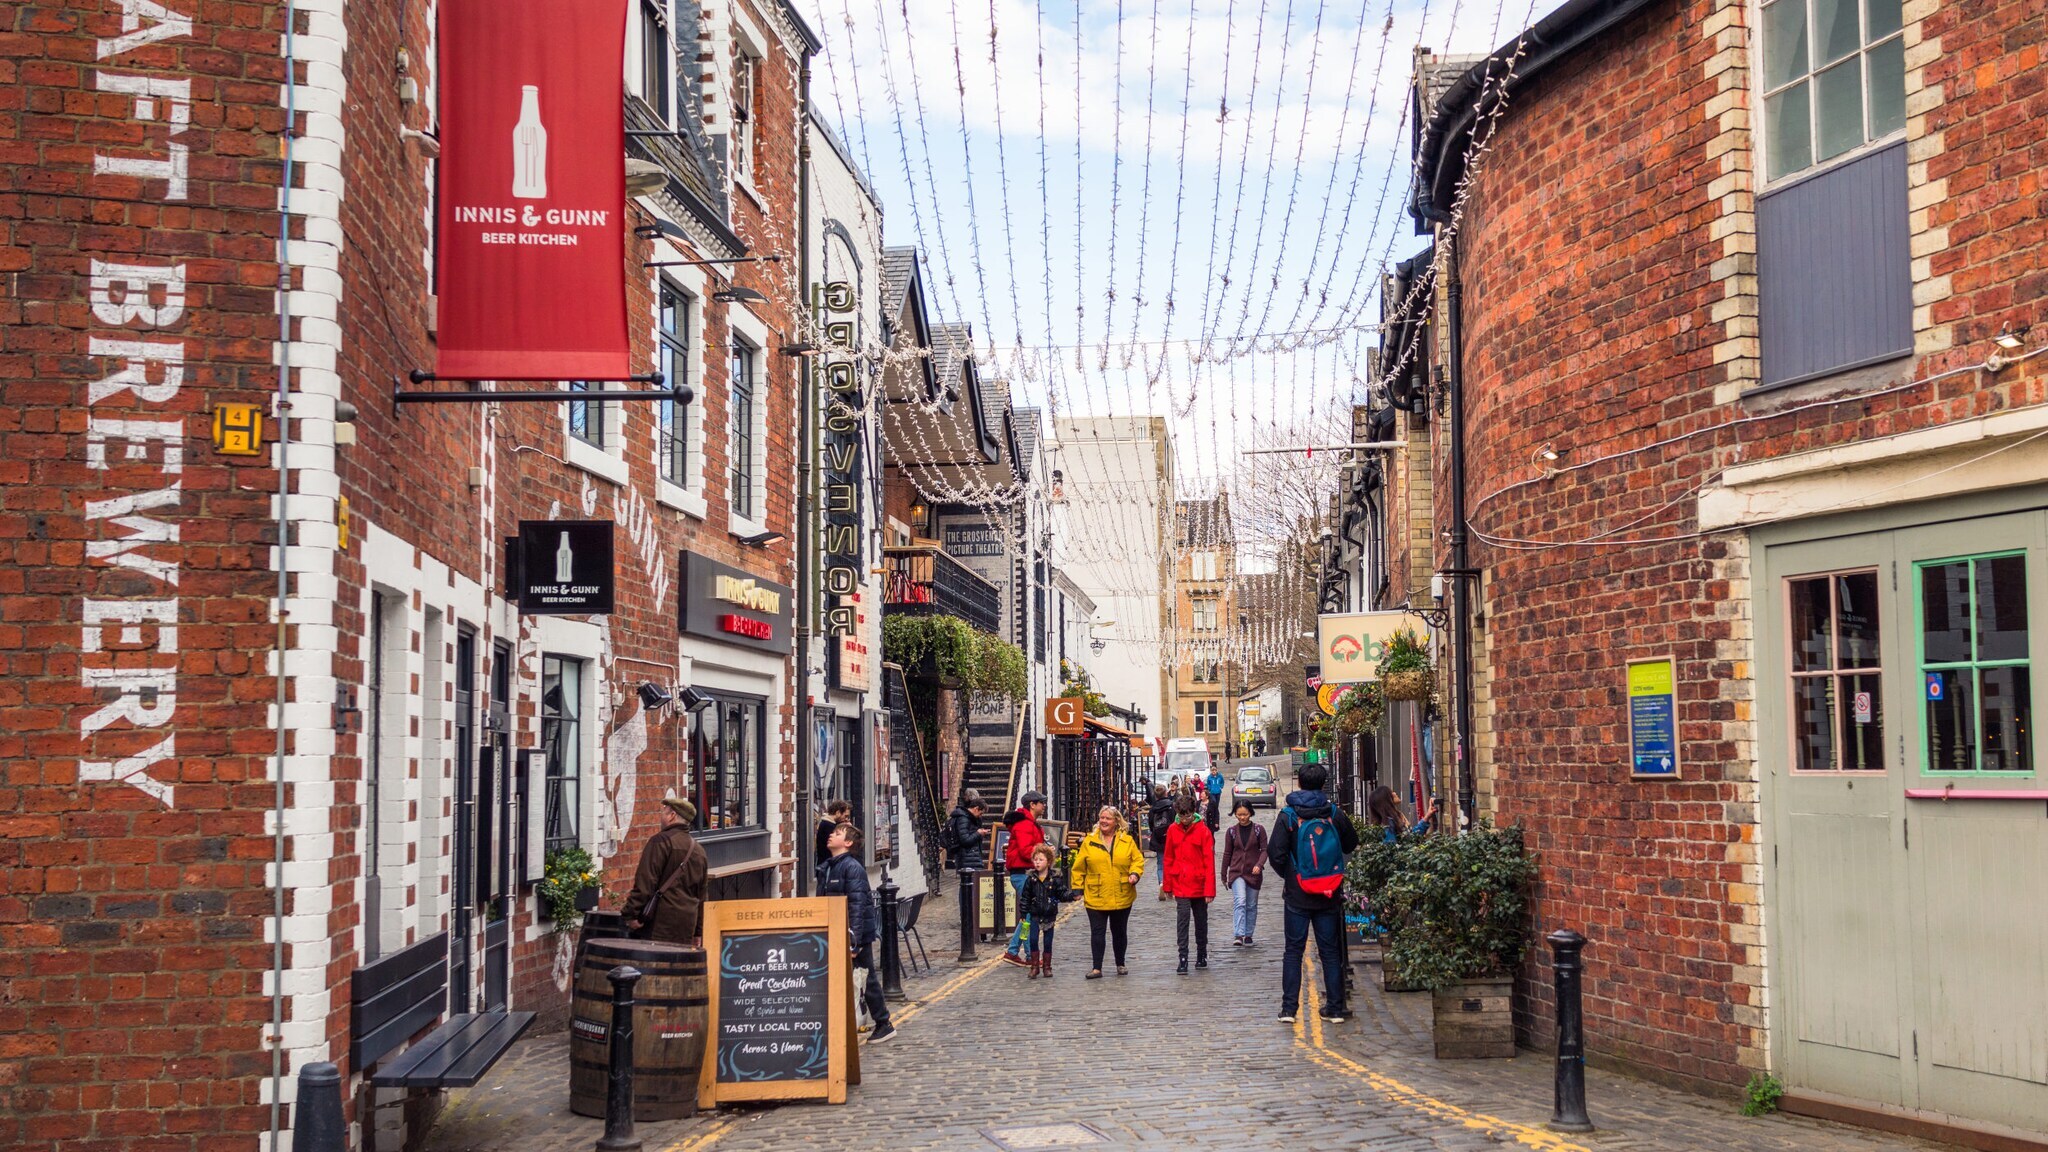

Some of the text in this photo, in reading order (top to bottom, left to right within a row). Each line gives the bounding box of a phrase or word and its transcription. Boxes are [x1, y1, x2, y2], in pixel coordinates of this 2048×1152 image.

[454, 205, 607, 227] INNIS & GUNN
[481, 232, 578, 246] BEER KITCHEN
[233, 411, 242, 422] 4
[233, 434, 242, 446] 2
[79, 257, 187, 810] BREWERY
[946, 531, 960, 543] THE
[946, 542, 1003, 555] PICTURE THEATRE
[530, 584, 598, 595] INNIS & GUNN
[1053, 702, 1076, 725] G
[736, 909, 813, 920] BEER KITCHEN
[766, 948, 786, 963] 21
[740, 962, 809, 972] CRAFT BEER TAPS
[738, 976, 807, 993] Great Cocktails
[733, 996, 811, 1006] WIDE SELECTION
[724, 1021, 822, 1033] TASTY LOCAL FOOD
[741, 1043, 768, 1055] Across
[769, 1042, 779, 1054] 3
